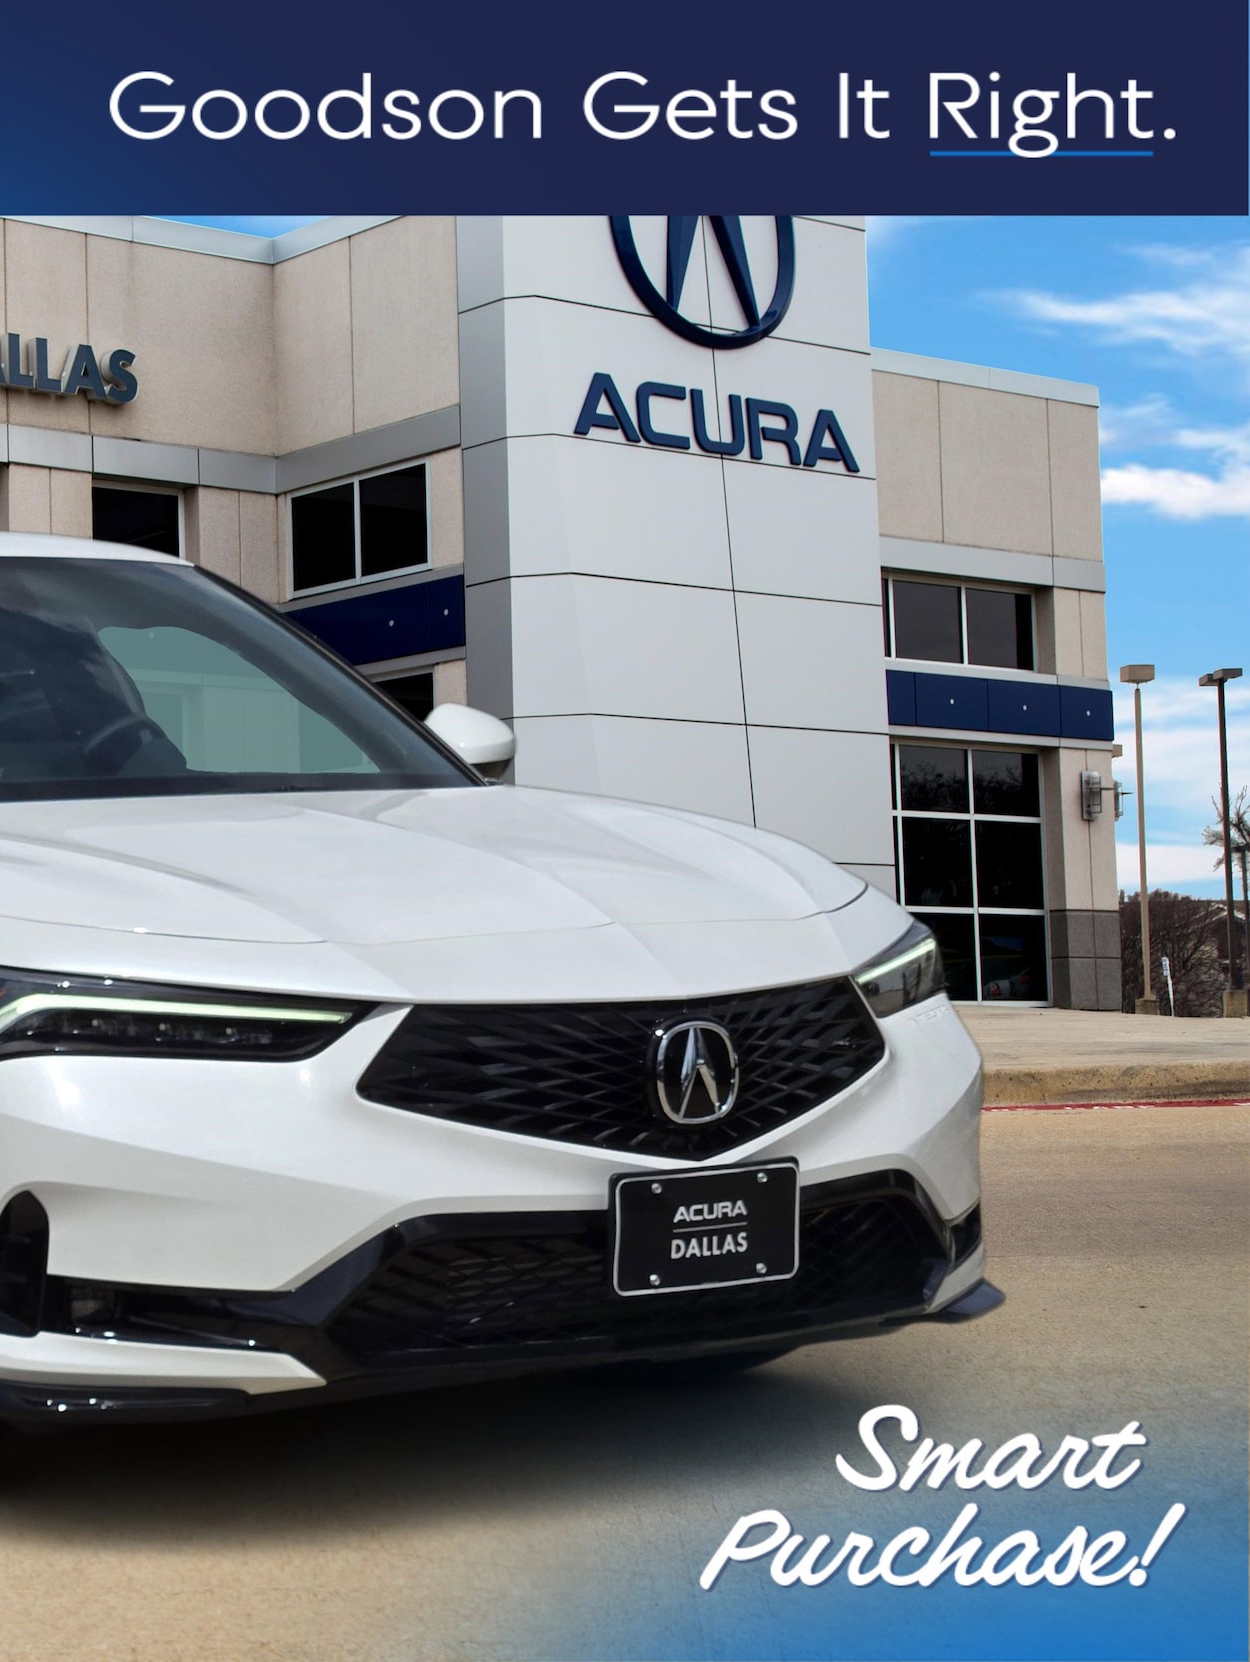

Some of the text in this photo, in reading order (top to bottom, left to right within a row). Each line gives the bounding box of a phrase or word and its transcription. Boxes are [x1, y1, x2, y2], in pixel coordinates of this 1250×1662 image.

[573, 371, 860, 473] ACURA
[673, 1200, 748, 1223] ACURA
[670, 1231, 748, 1259] DALLAS
